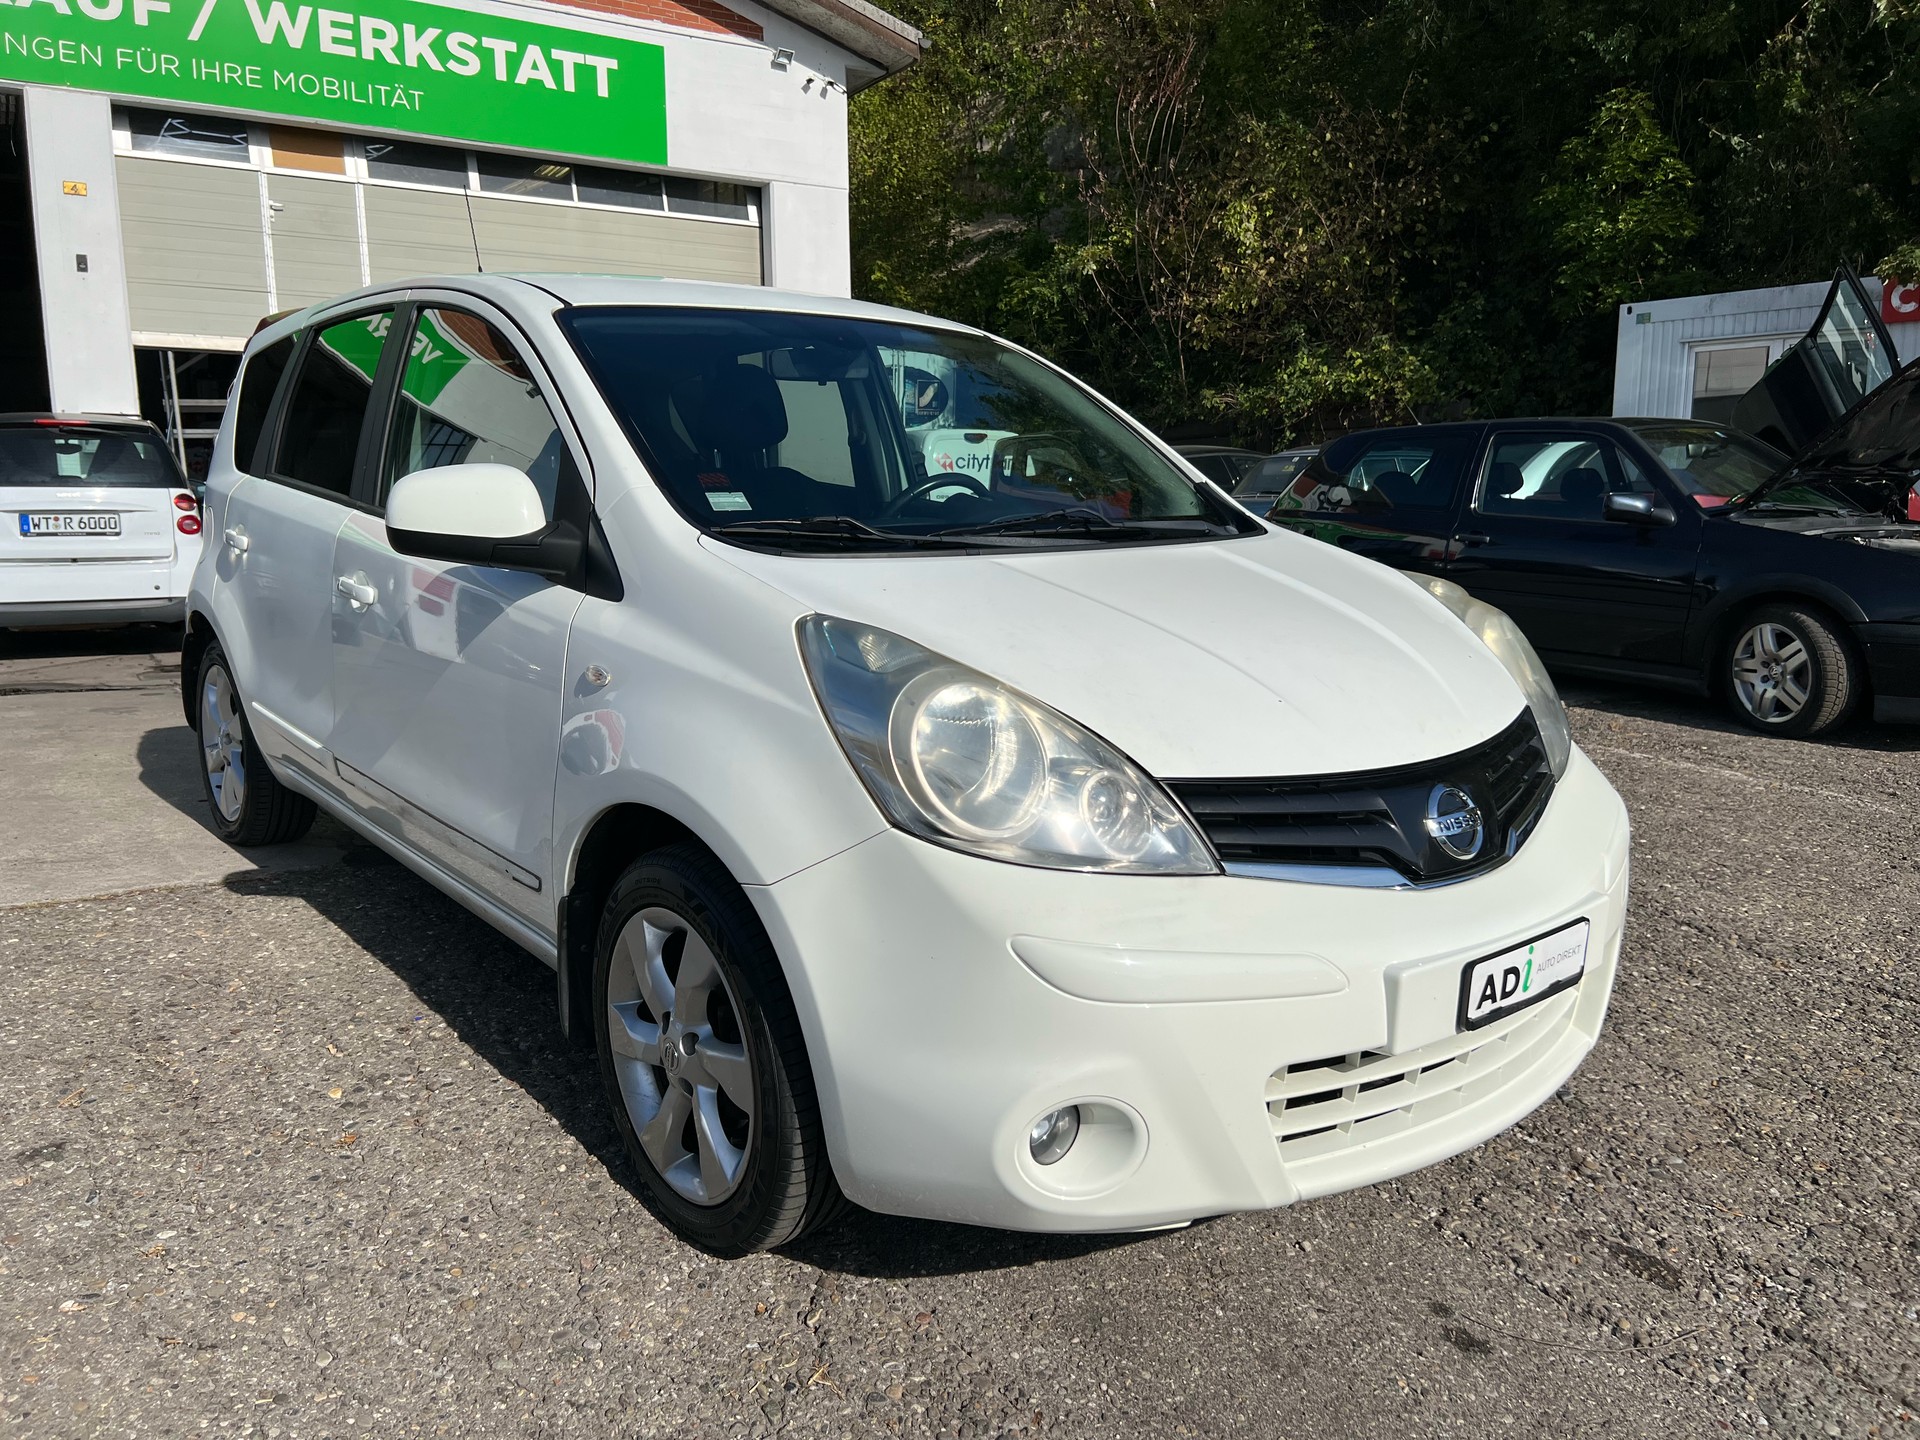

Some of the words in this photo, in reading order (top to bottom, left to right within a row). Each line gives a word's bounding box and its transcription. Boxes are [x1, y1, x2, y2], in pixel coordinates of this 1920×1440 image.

[4, 31, 103, 68] NGEN
[115, 46, 181, 78] FÜR
[192, 57, 263, 89] IHRE
[273, 70, 425, 112] MOBILITÄT
[242, 0, 619, 99] WERKSTATT
[31, 516, 52, 531] WT
[64, 516, 74, 531] R
[78, 516, 118, 531] 6000
[1536, 956, 1555, 974] AUTO
[1556, 944, 1582, 964] DIREKT
